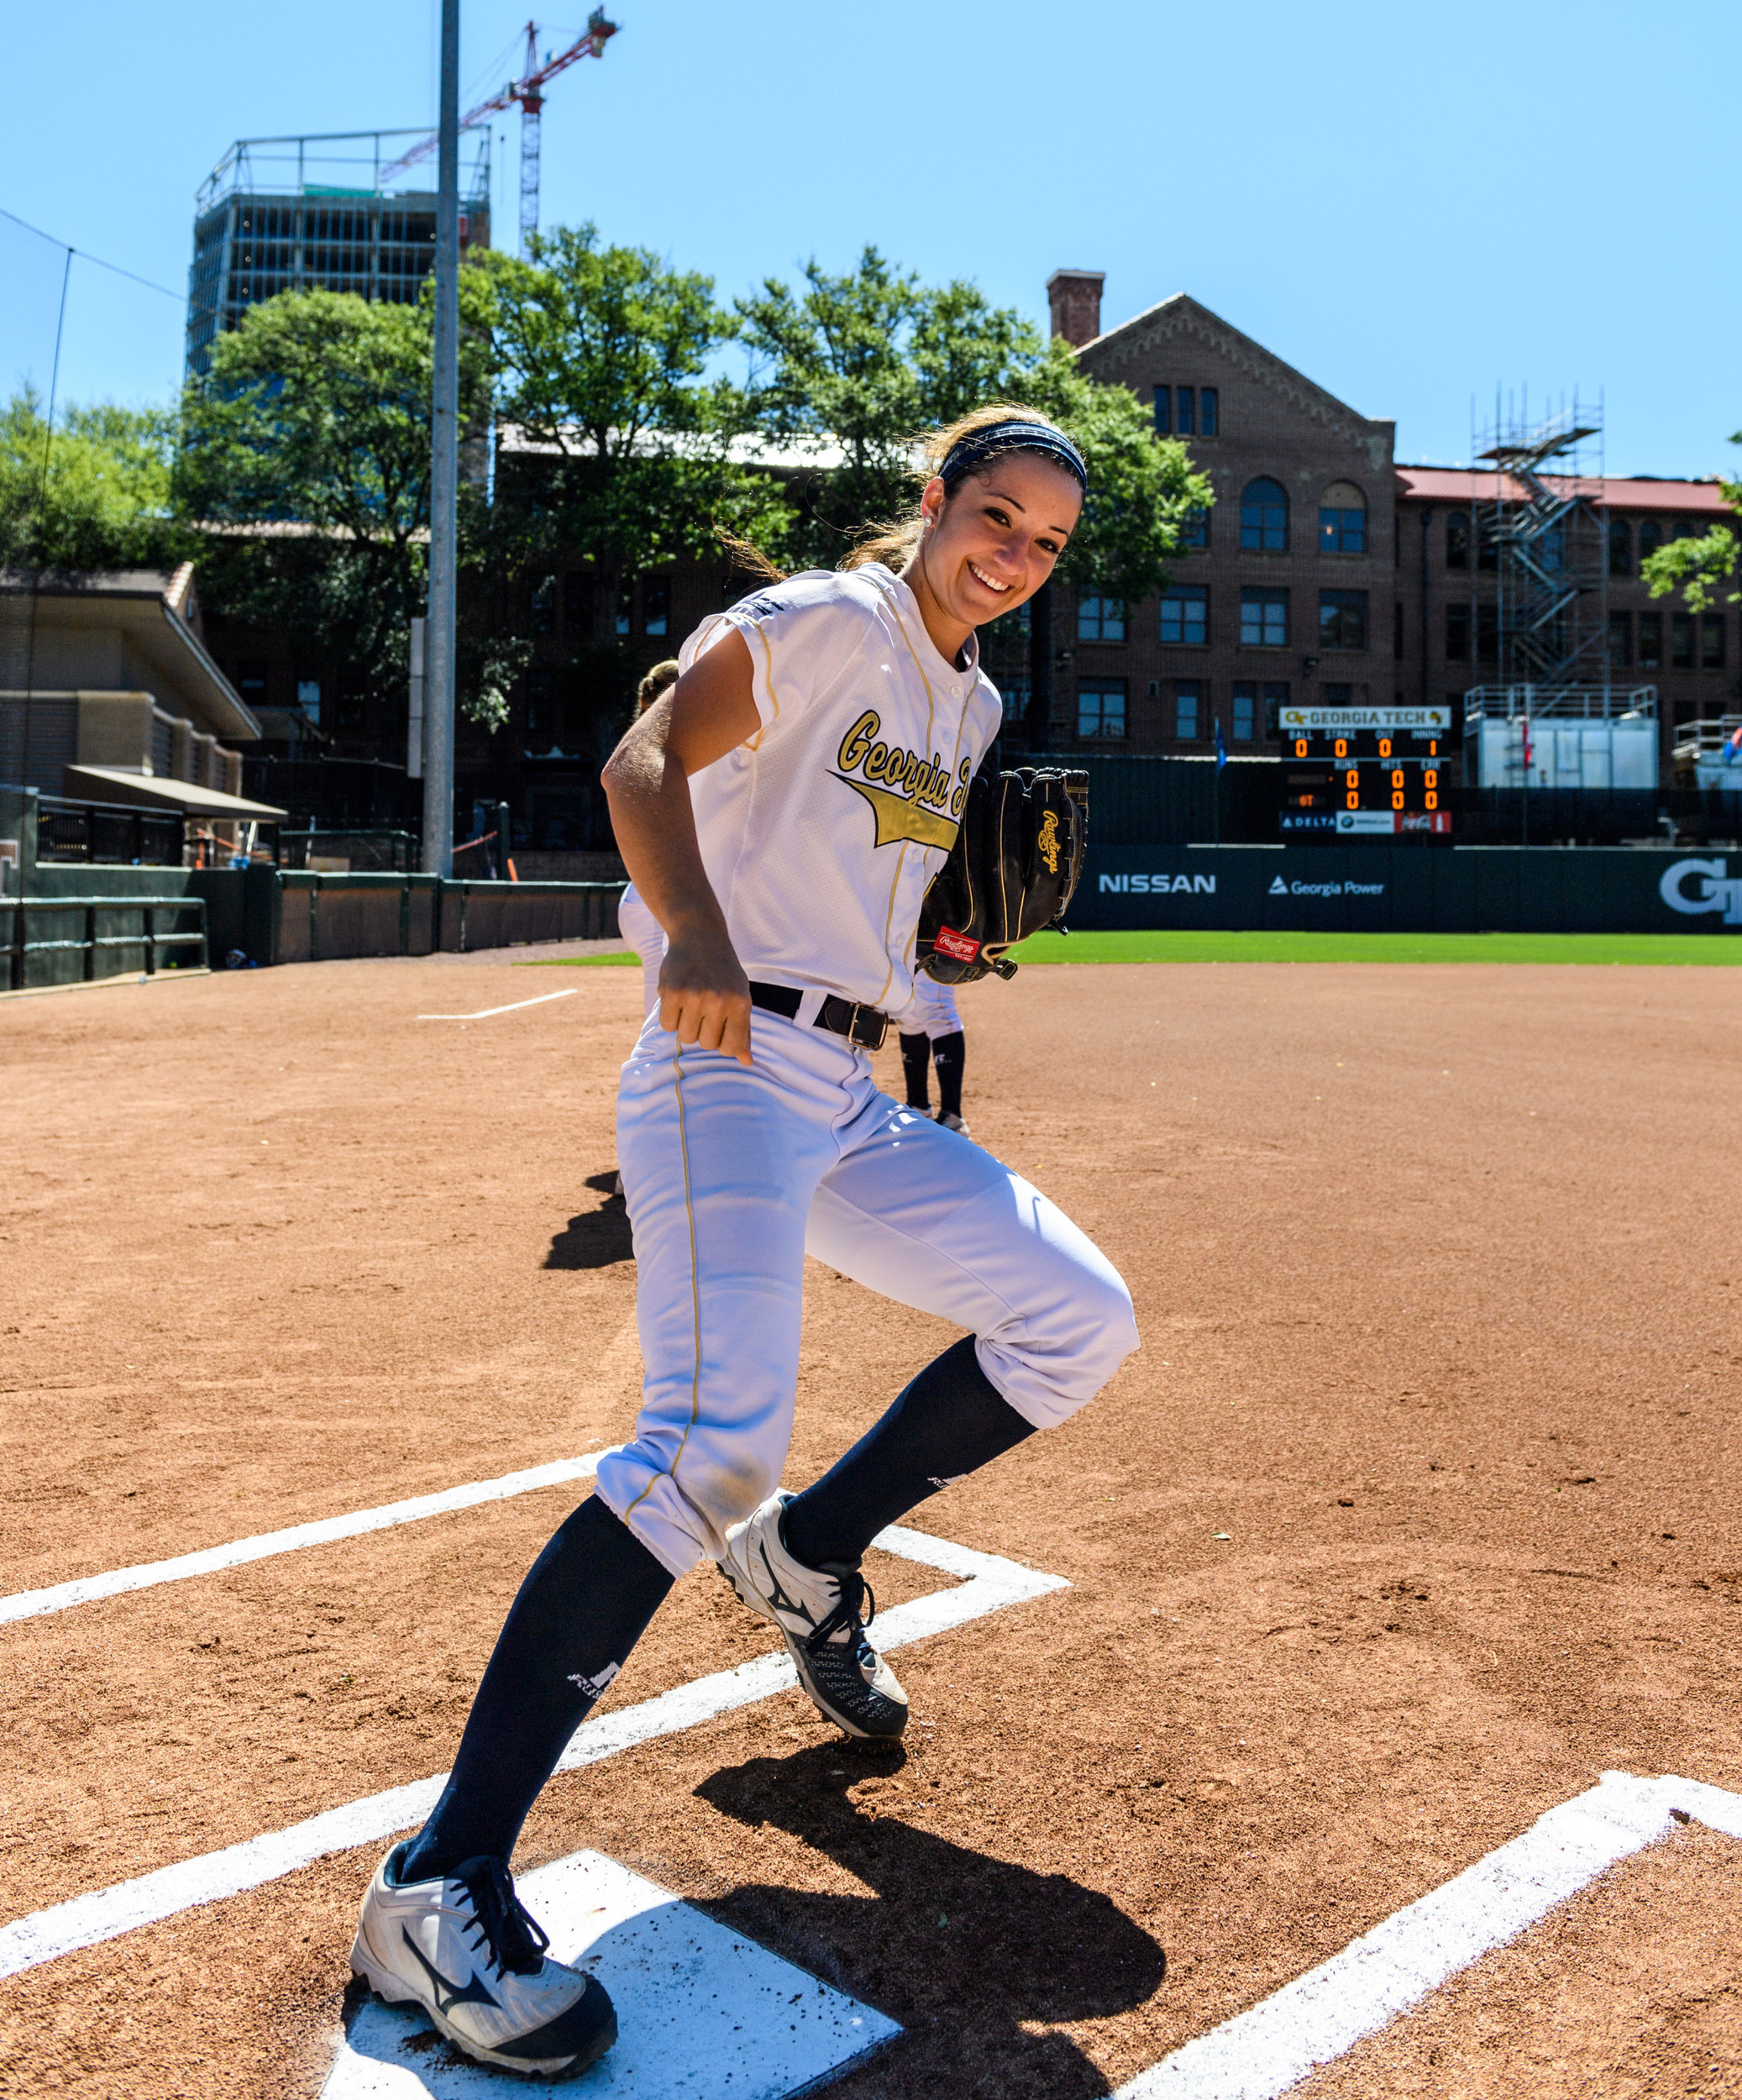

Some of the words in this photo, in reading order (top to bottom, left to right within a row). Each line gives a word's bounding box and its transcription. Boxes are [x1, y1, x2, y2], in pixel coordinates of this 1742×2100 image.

[1310, 711, 1380, 724] GEORGIA
[1385, 711, 1425, 724] TECH
[1295, 738, 1308, 758] 0
[1335, 738, 1347, 758] 0
[1379, 738, 1392, 758] 0
[1430, 739, 1436, 756] 1
[837, 709, 949, 809] Georgia
[1346, 769, 1359, 789] 0
[1392, 769, 1404, 789] 0
[1425, 769, 1437, 789] 0
[1346, 790, 1359, 810] 0
[1392, 790, 1404, 810] 0
[1425, 790, 1437, 810] 0
[1295, 816, 1335, 827] DELTA
[1038, 810, 1061, 874] Rawlings
[1099, 874, 1216, 893] NISSAN
[1291, 881, 1341, 897] Georgia
[1345, 881, 1385, 895] Power
